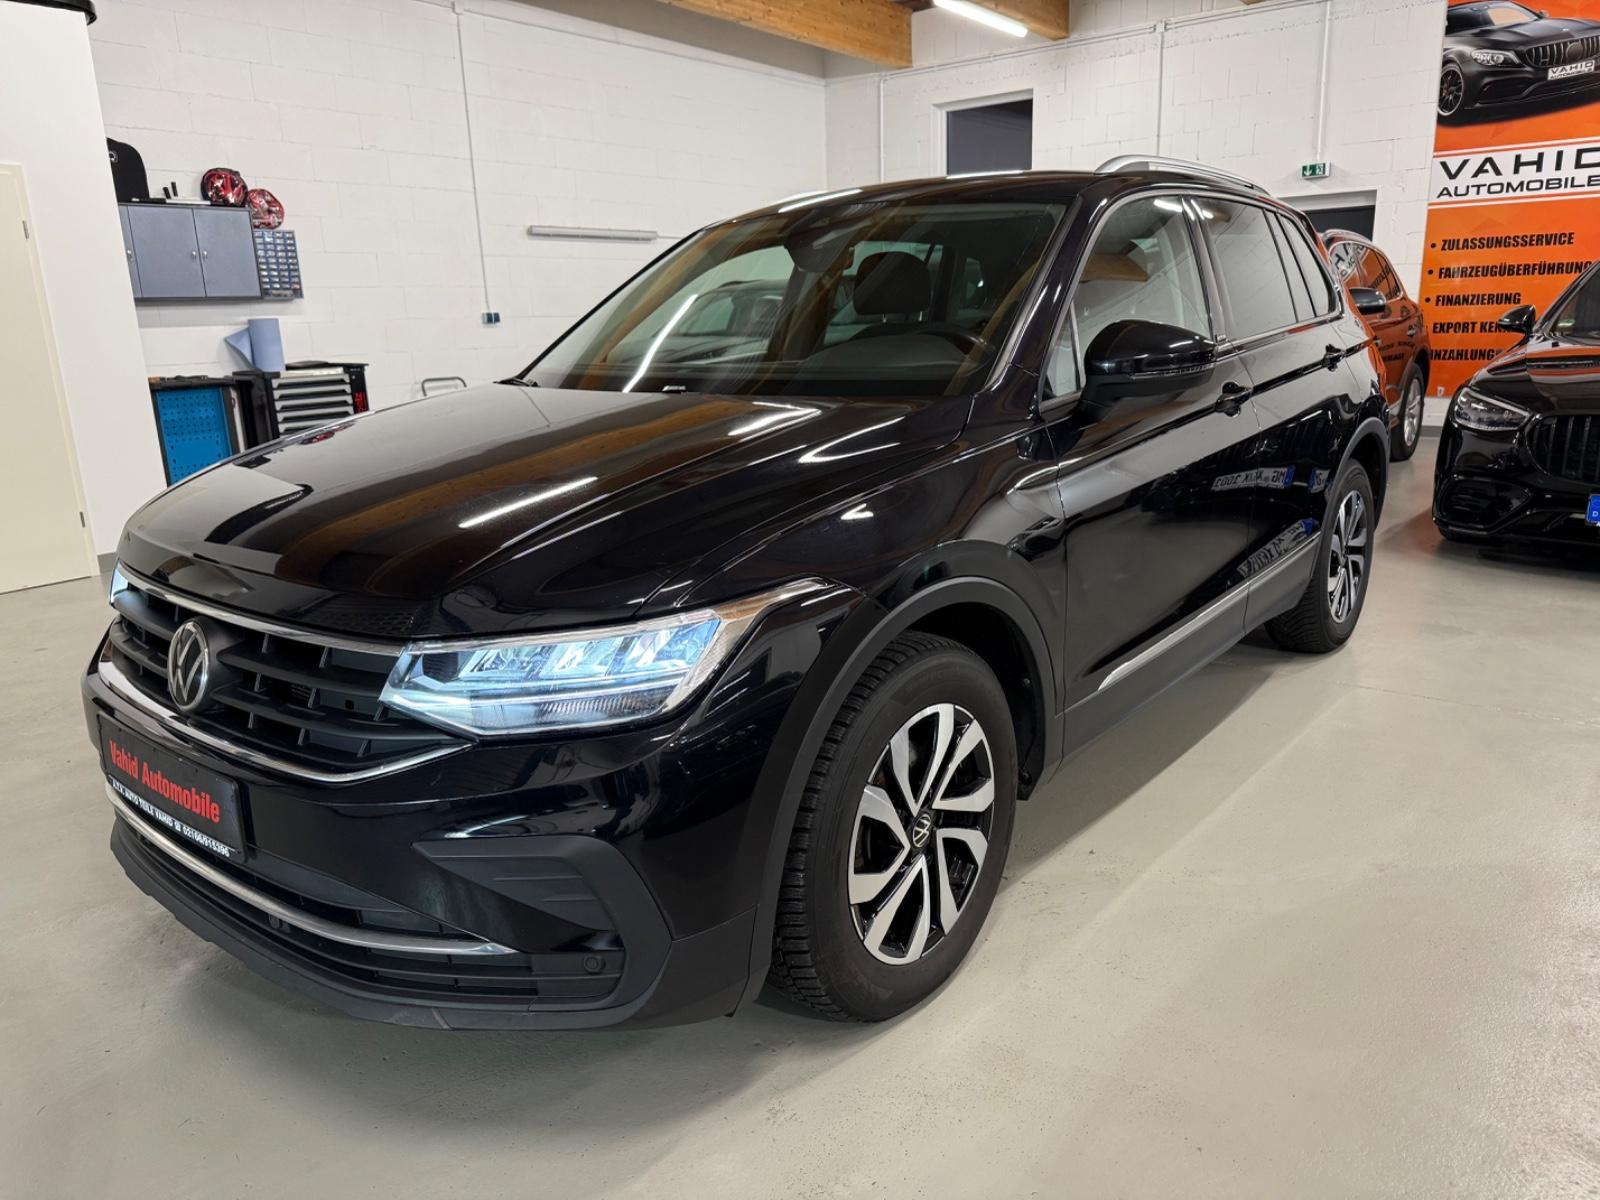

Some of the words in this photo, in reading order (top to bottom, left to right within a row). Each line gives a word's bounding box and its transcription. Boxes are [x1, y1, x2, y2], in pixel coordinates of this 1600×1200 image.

[1436, 174, 1600, 199] AUTOMOBILE
[1441, 232, 1575, 251] ZULASSUNGSSERVICE
[1435, 292, 1522, 307] FINANZIERUNG
[1432, 321, 1477, 334] EXPORT
[109, 739, 139, 780] Vahid
[142, 760, 220, 824] Automobile
